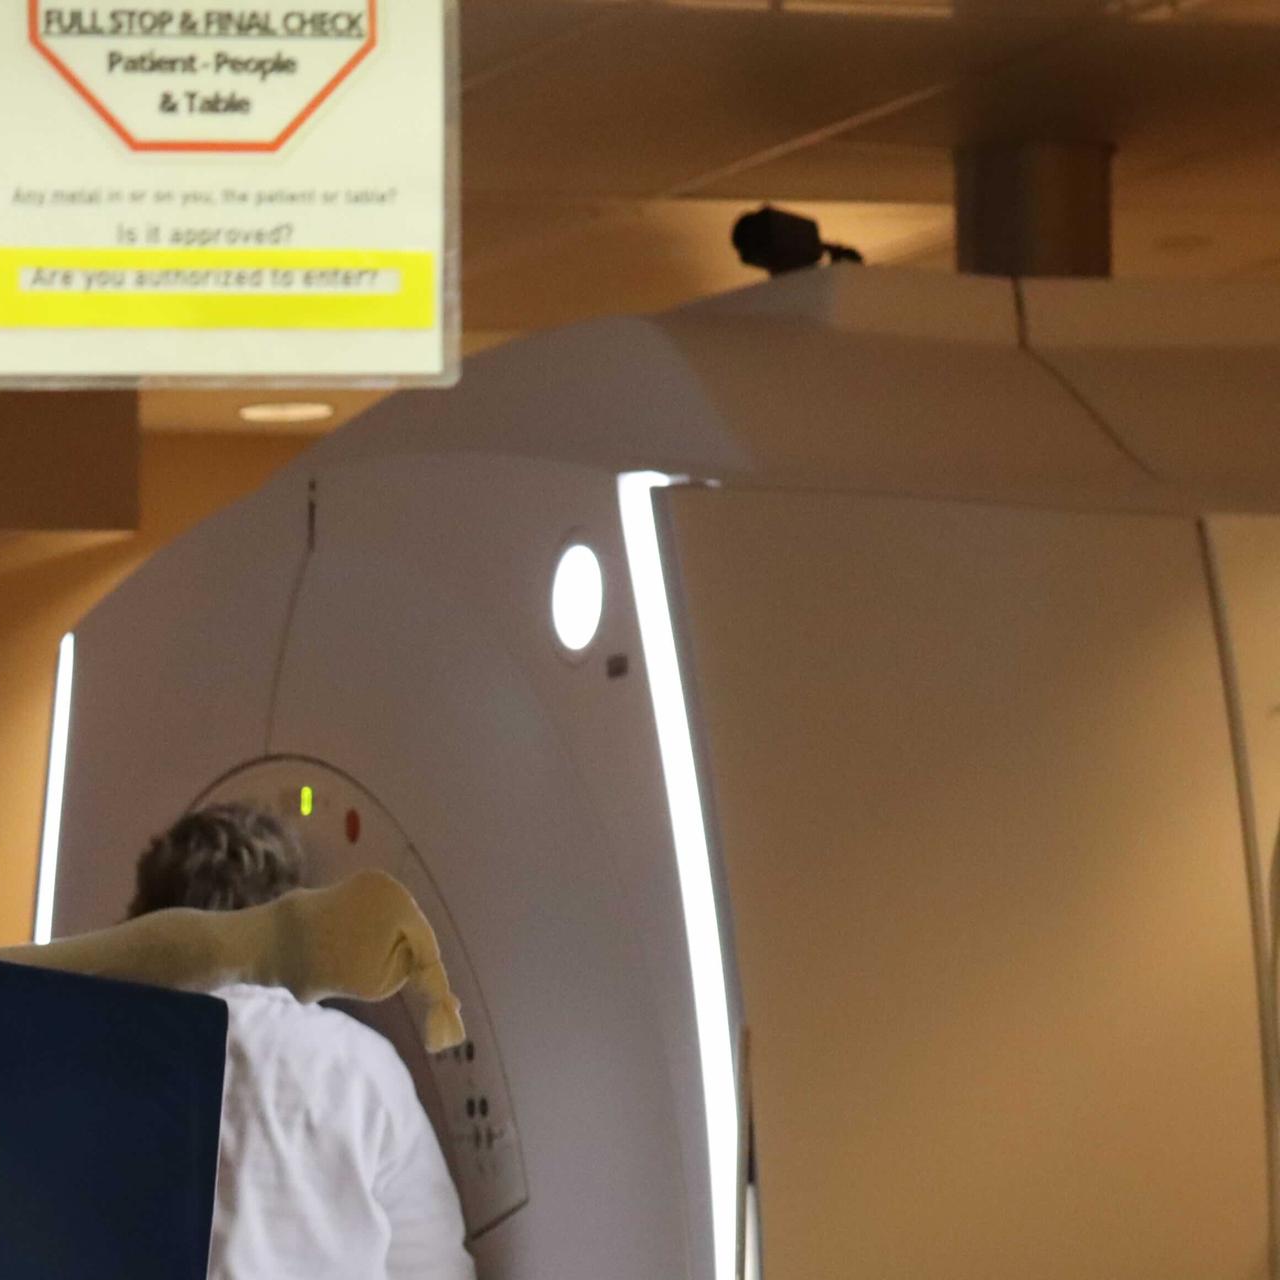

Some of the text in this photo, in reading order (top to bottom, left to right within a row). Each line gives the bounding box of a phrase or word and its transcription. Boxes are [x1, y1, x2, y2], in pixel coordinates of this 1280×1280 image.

[45, 9, 364, 36] FULL STOP & FINAL CHECK
[107, 51, 197, 74] Patient
[214, 51, 297, 81] People
[159, 93, 251, 114] & Table
[52, 188, 101, 205] metal
[221, 188, 249, 204] the
[255, 188, 316, 207] patient
[345, 187, 398, 204] table?
[117, 222, 293, 248] Is it approved?
[30, 267, 379, 290] Are you authorized to enter?
